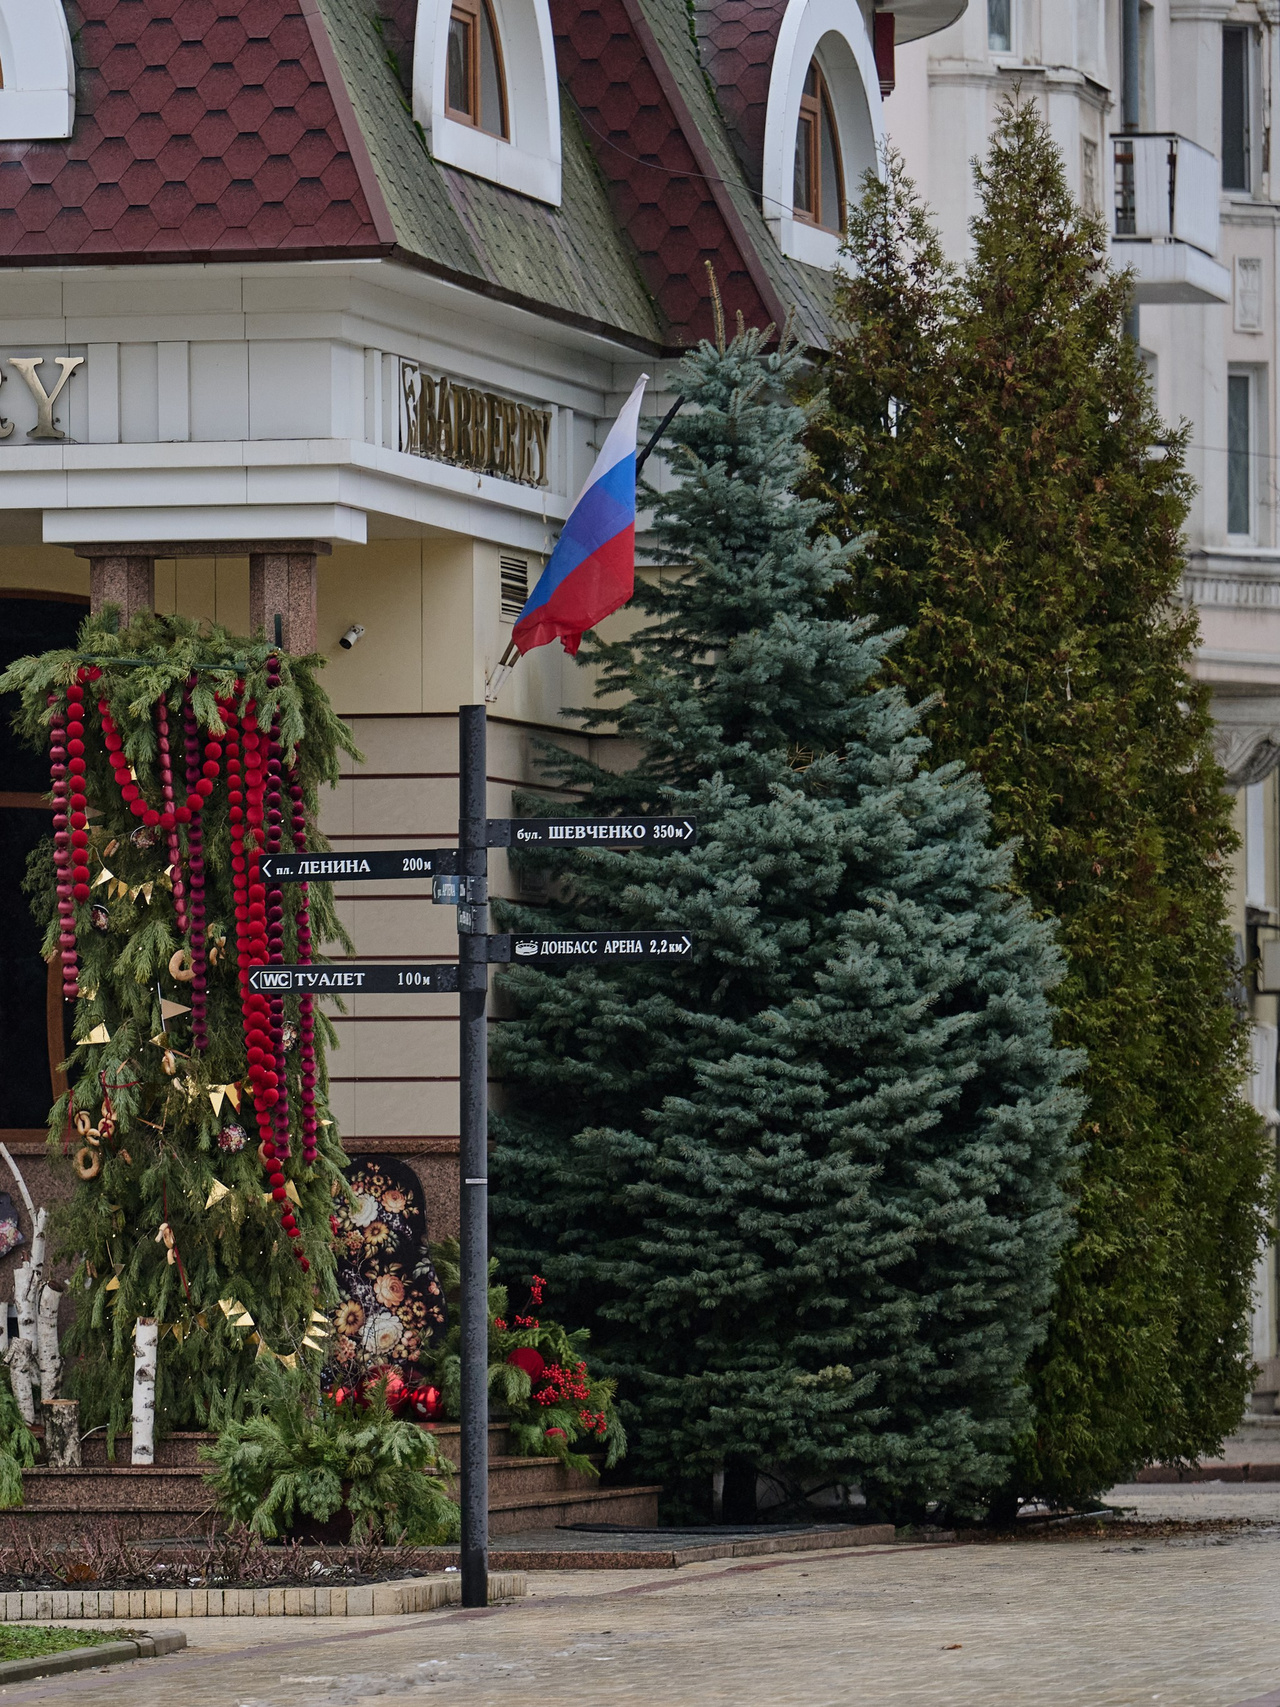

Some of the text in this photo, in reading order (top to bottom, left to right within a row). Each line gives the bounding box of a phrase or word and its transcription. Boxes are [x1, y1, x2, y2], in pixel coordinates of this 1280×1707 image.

[419, 373, 553, 487] BARBERRY
[517, 824, 683, 842] бул. ШЕВЧЕНКО 350м
[276, 857, 432, 875] пл. ЛЕНИНА 200м
[540, 940, 598, 955] ДОНБАСС
[604, 940, 643, 953] АРЕНА
[263, 972, 431, 986] WC ТУАЛЕТ 100м
